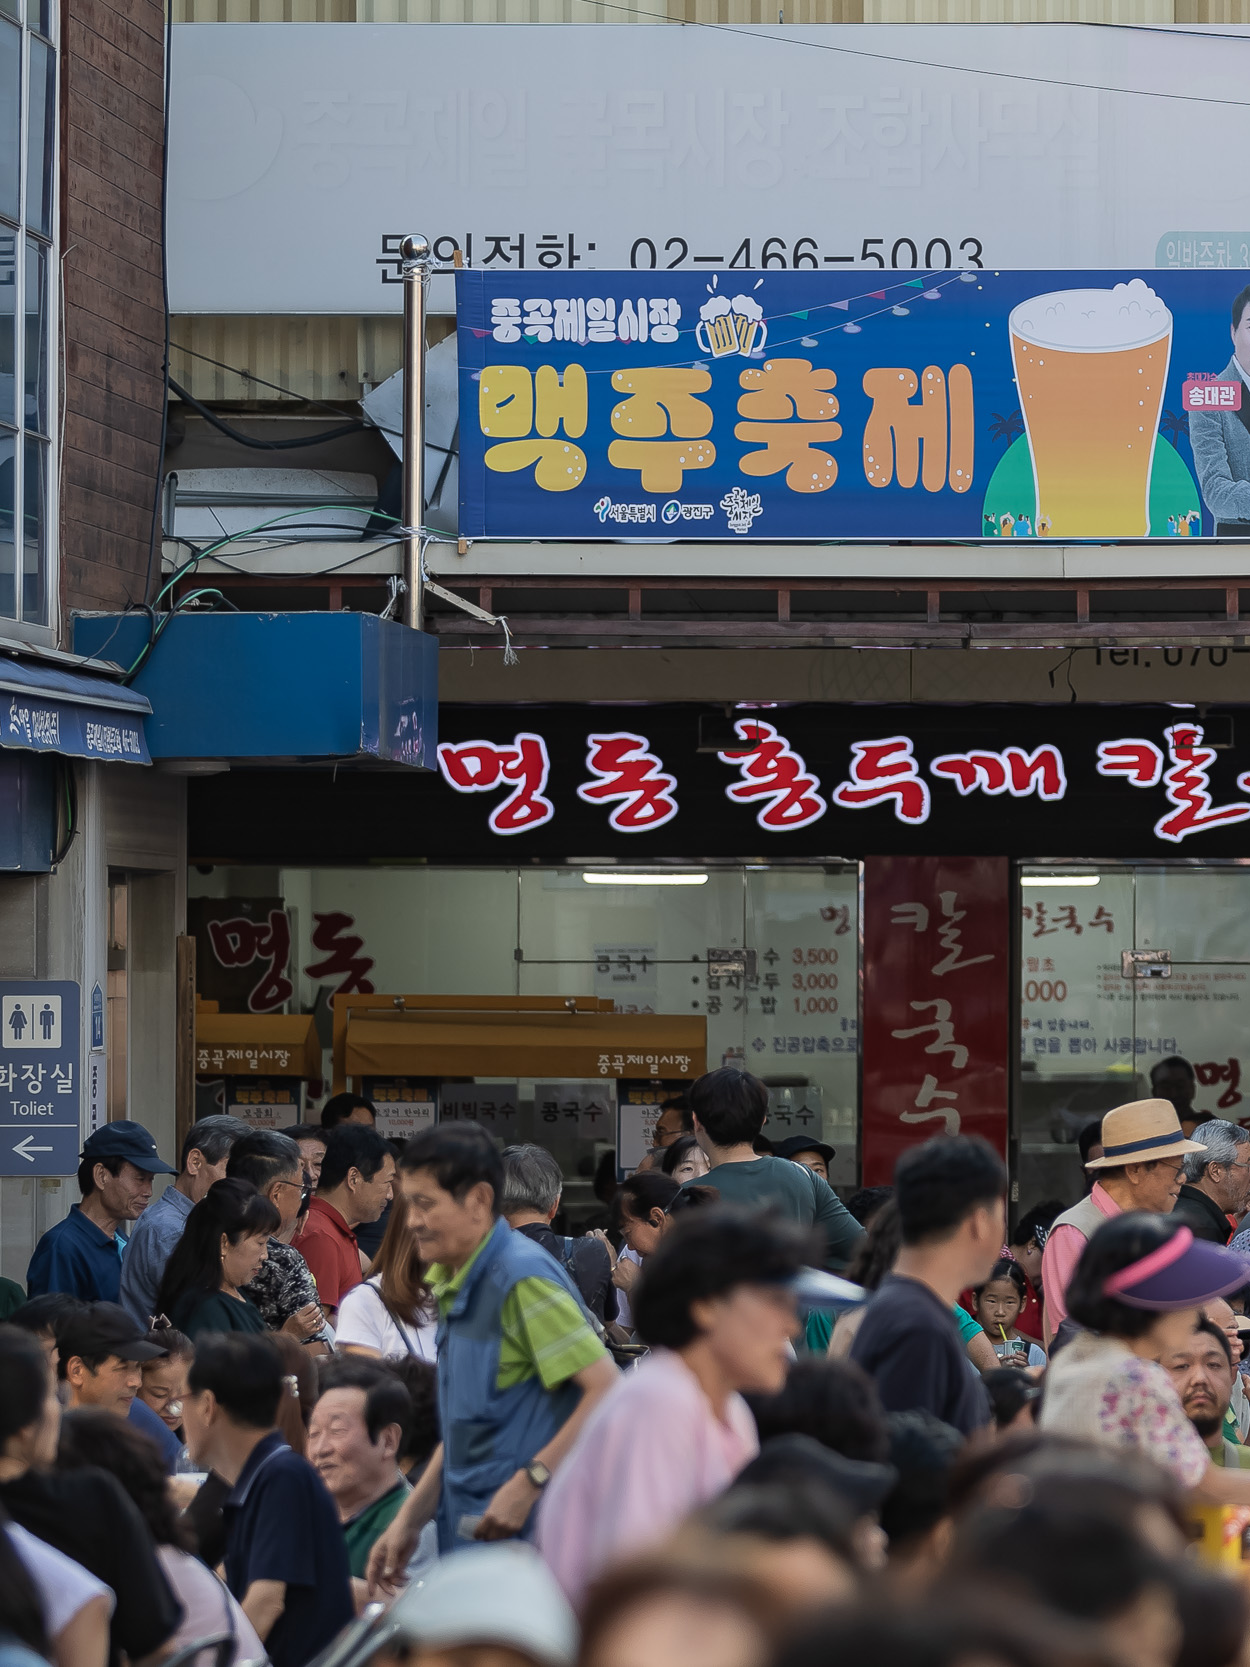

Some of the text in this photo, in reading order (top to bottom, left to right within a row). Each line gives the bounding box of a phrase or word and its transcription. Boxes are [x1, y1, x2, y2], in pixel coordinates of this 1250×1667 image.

[490, 297, 682, 343] 중곡제일시장
[1188, 386, 1236, 406] 송대관
[609, 506, 656, 521] 서울특별시
[682, 505, 713, 518] 광진구
[437, 732, 678, 836] 명동
[791, 948, 839, 966] 3,500
[791, 973, 839, 992] 3,000
[794, 997, 839, 1015] 1,000
[890, 890, 996, 1138] 칼국수
[197, 1049, 292, 1070] 중곡제일시장
[597, 1054, 692, 1075] 중곡제일시장
[10, 1101, 55, 1117] Toliet
[541, 1102, 603, 1123] 콩국수
